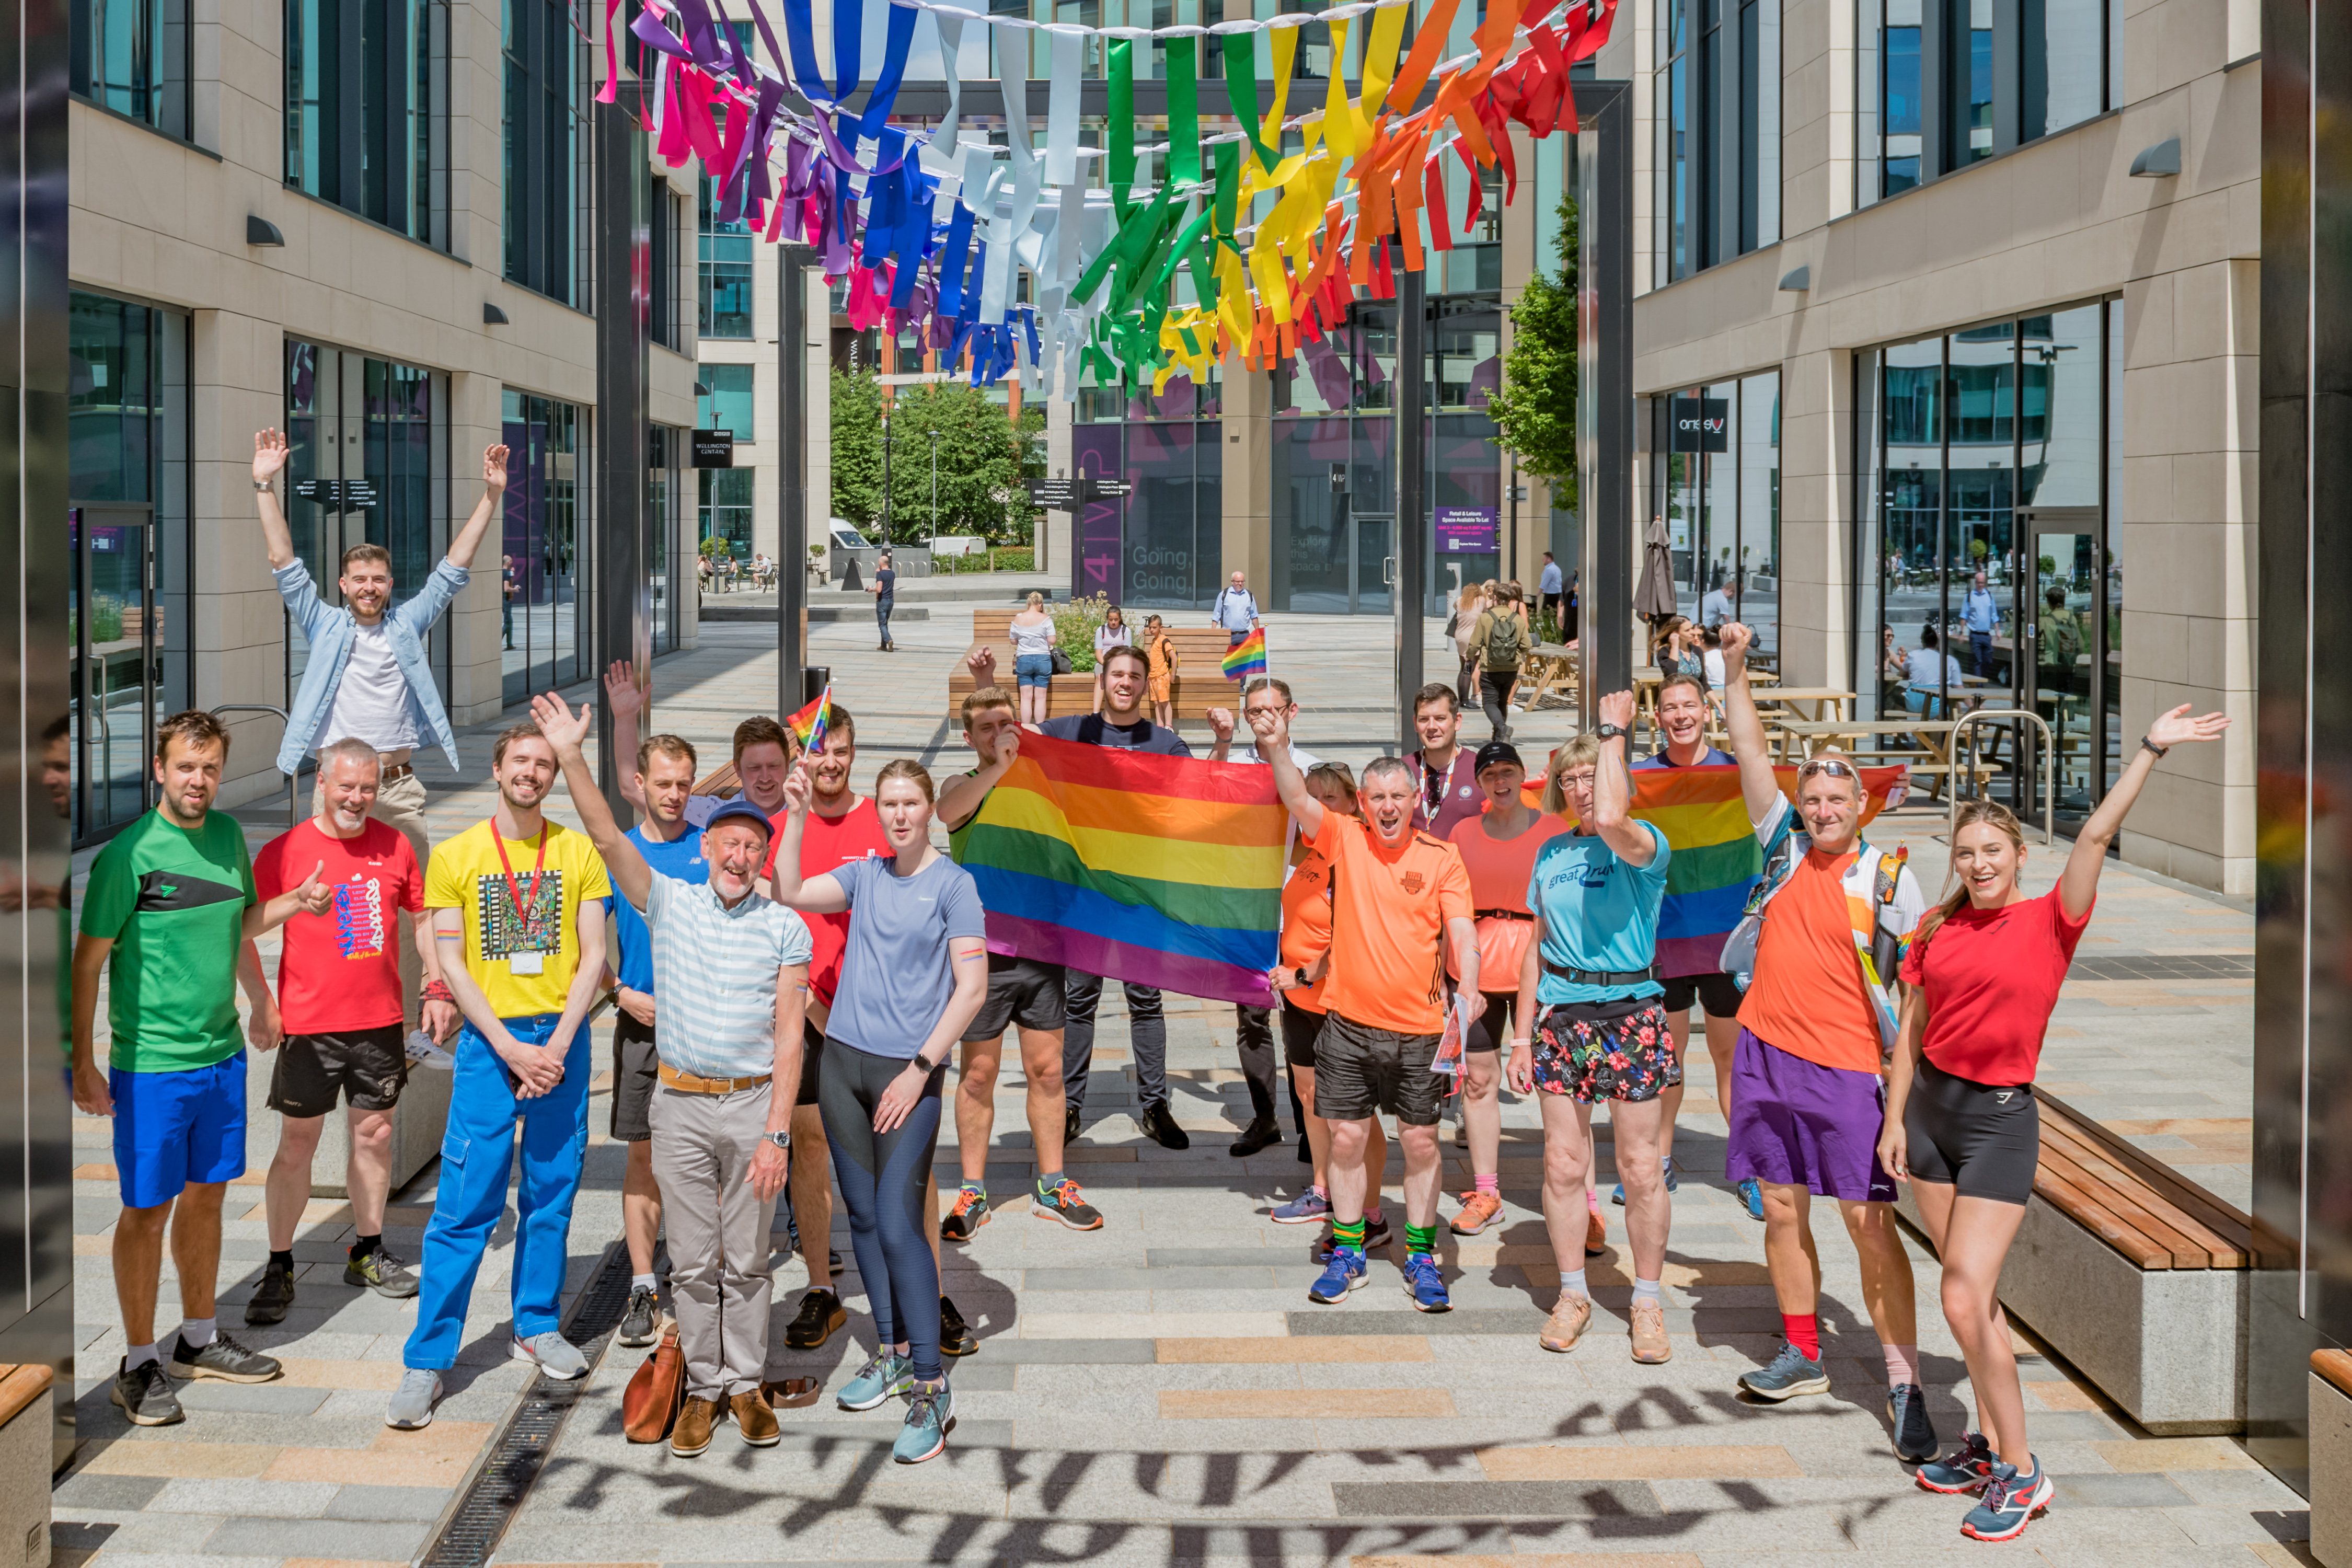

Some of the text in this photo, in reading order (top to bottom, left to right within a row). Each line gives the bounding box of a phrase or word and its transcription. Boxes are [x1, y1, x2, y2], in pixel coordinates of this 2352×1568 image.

[1291, 536, 1328, 548] Explore
[1133, 546, 1192, 570] Going,
[1290, 548, 1308, 559] this
[1290, 563, 1320, 573] space
[1133, 570, 1192, 594] Going,
[1548, 863, 1615, 890] great run
